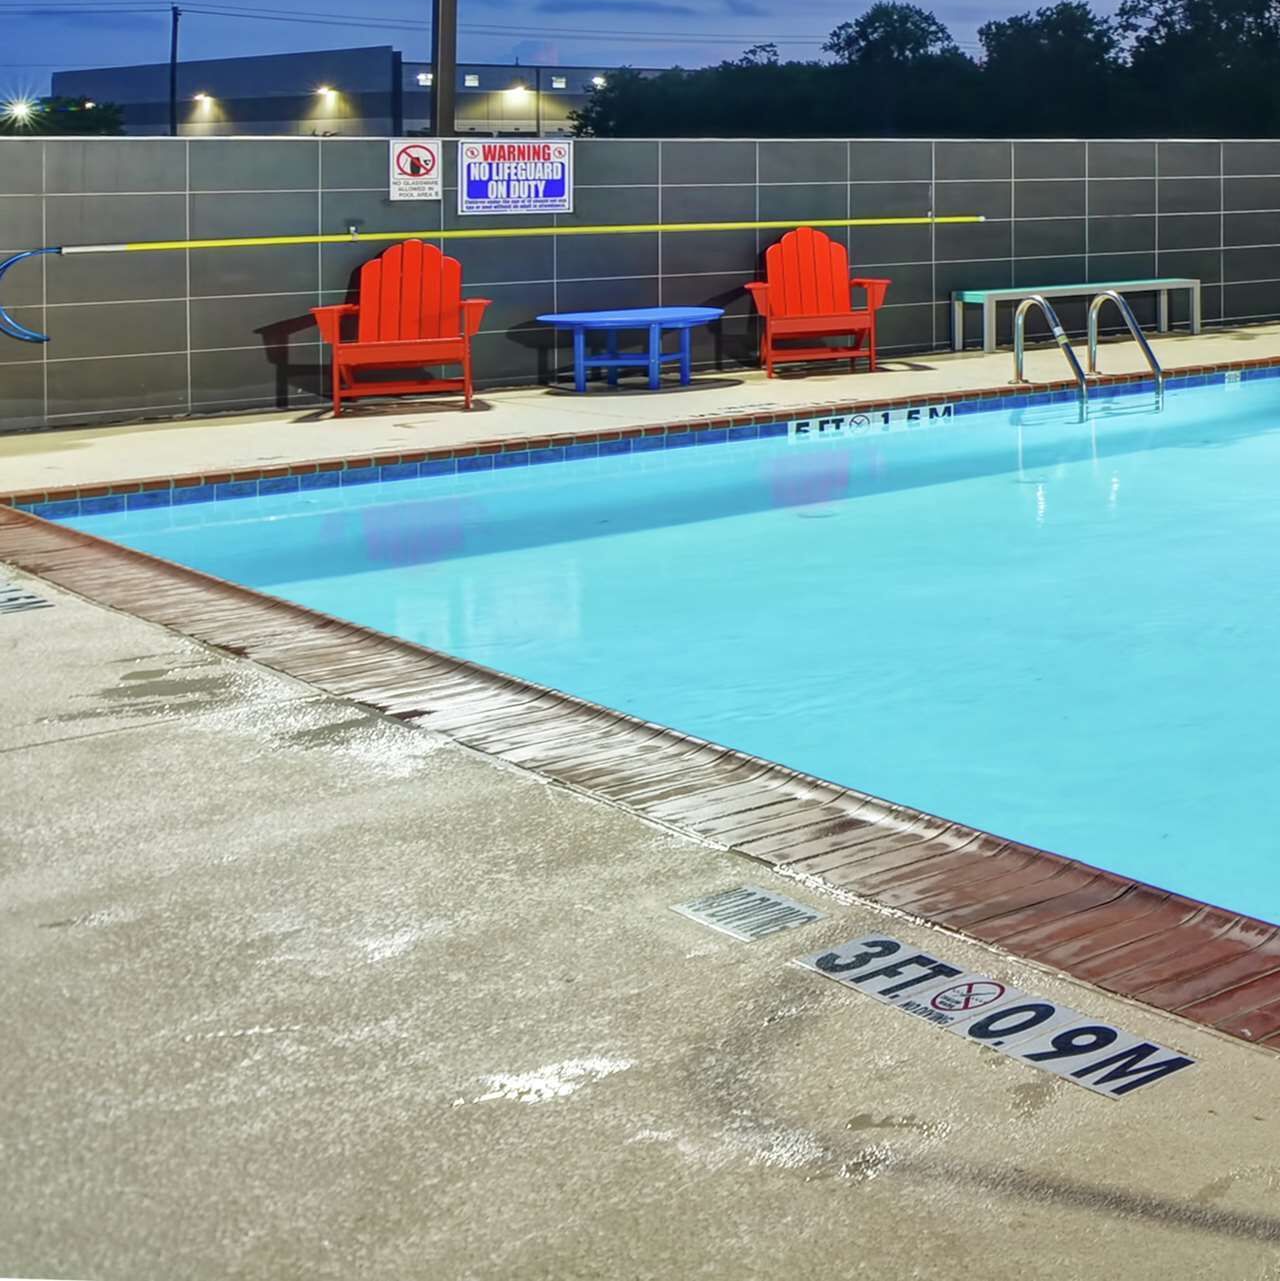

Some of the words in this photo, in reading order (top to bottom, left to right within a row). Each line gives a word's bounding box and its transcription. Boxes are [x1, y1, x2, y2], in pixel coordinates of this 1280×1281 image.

[482, 144, 551, 161] WARNING
[470, 163, 490, 181] NO
[492, 162, 562, 180] LIFEGUARD
[487, 180, 508, 199] ON
[509, 180, 546, 198] DUTY
